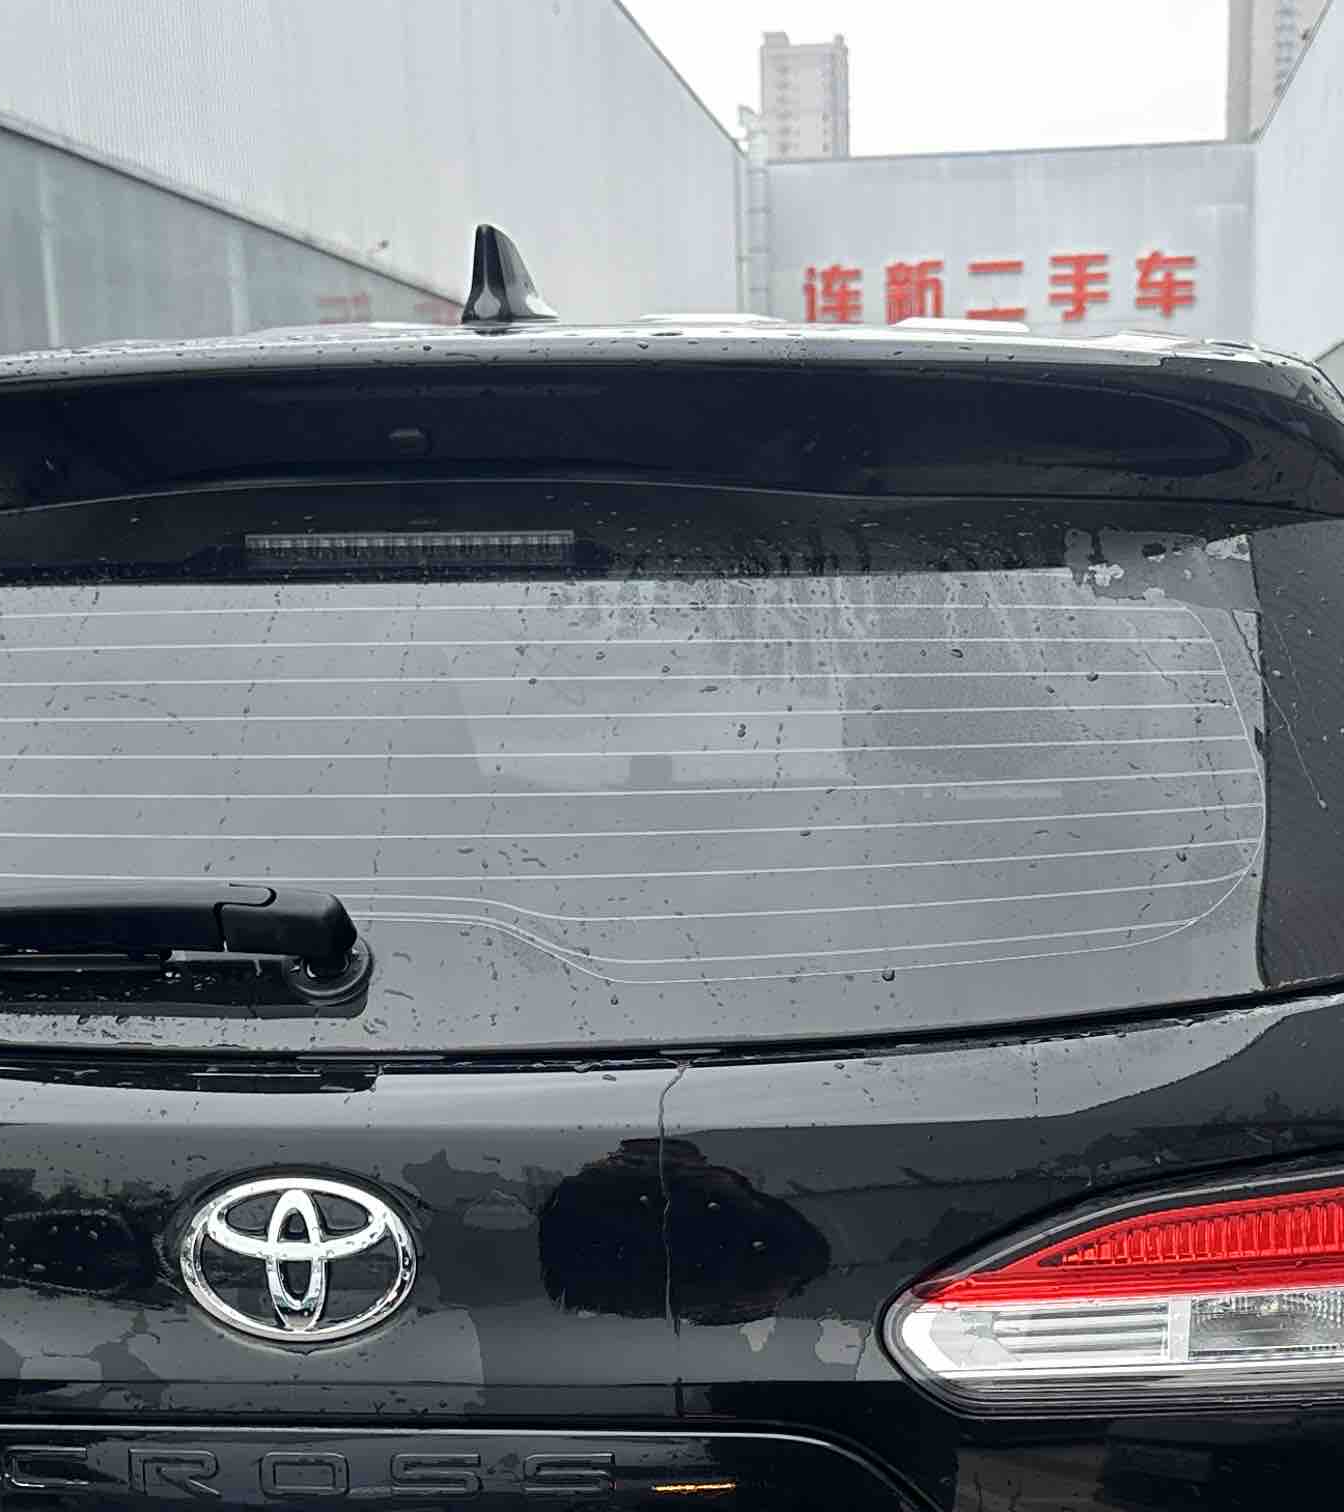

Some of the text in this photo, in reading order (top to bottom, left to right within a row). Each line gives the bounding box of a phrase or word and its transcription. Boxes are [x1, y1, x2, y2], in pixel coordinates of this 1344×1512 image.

[803, 250, 1197, 325] 连新二手车
[4, 1446, 615, 1497] CROSS
